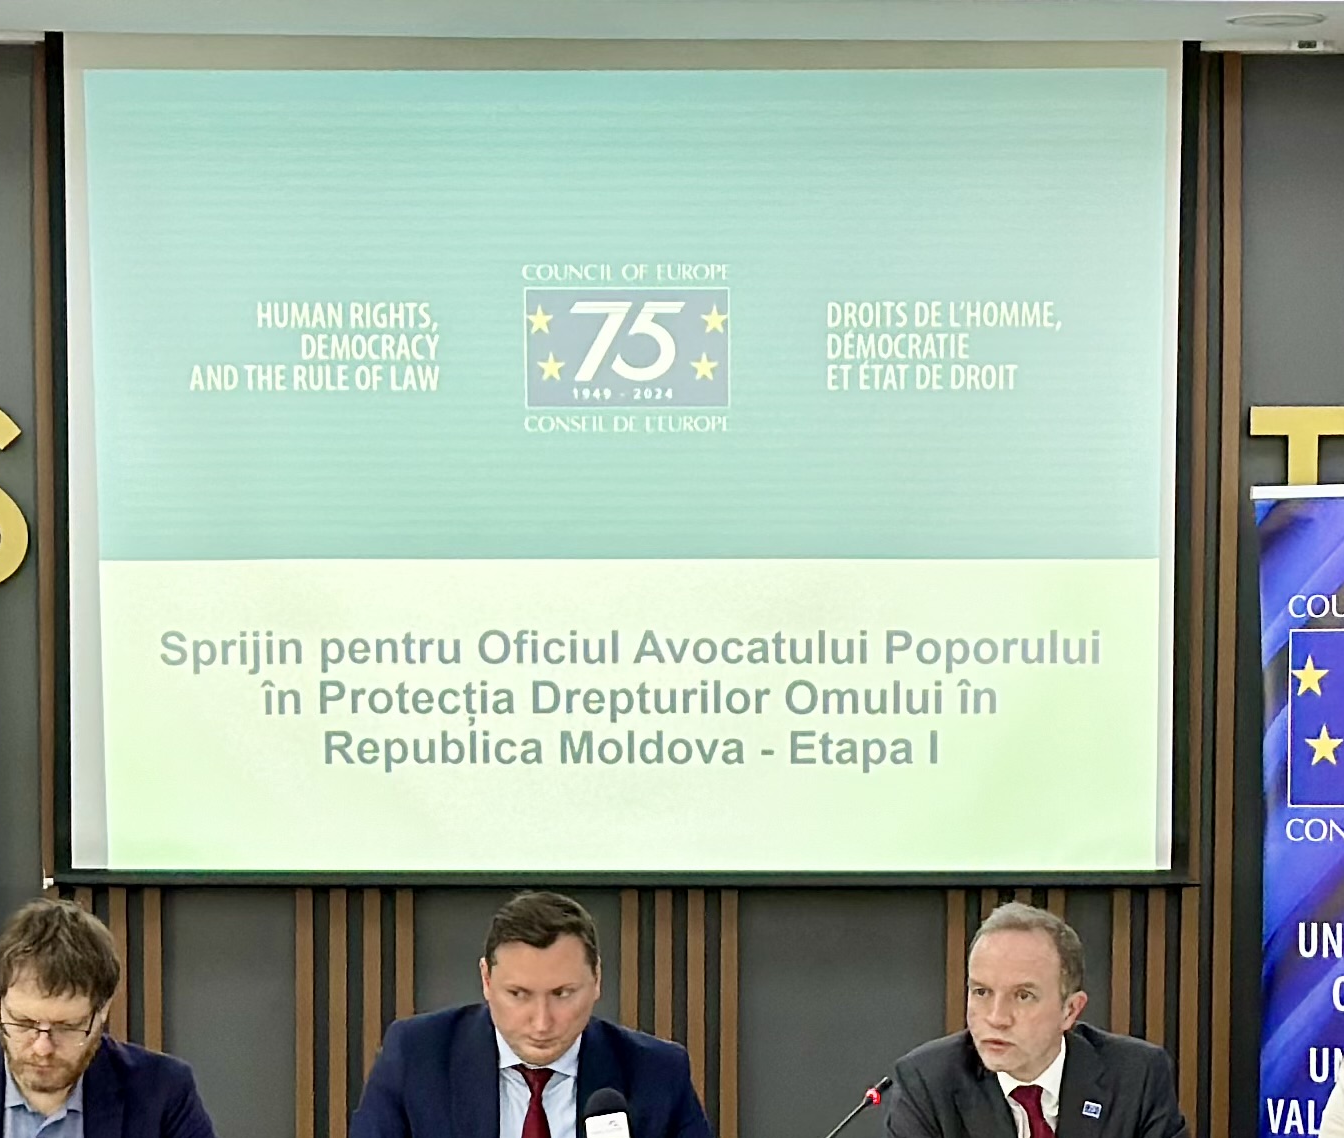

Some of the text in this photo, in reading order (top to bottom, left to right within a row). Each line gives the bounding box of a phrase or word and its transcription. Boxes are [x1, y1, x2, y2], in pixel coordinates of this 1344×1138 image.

[521, 263, 730, 281] COUNCIL OF EUROPE
[257, 301, 439, 333] HUMAN RIGHTS,
[826, 301, 1062, 332] DROITS DE L'HOMME,
[301, 333, 440, 361] DEMOCRACY
[569, 301, 686, 382] 75
[826, 329, 970, 360] DÉMOCRATIE
[189, 364, 440, 392] AND THE RULE OF LAW
[826, 360, 1019, 391] ET ÉTAT DE DROIT
[572, 387, 612, 400] 1949
[632, 387, 673, 400] 2024
[523, 415, 604, 433] CONSEIL
[613, 415, 637, 432] DE
[159, 628, 1102, 675] Sprijin pentru Oficiul Avocatului Poporului
[260, 678, 998, 726] în Protecția Drepturilor Omului în
[324, 729, 544, 773] Republica
[560, 729, 745, 766] Moldova
[789, 730, 914, 774] Etapa
[929, 730, 939, 765] I
